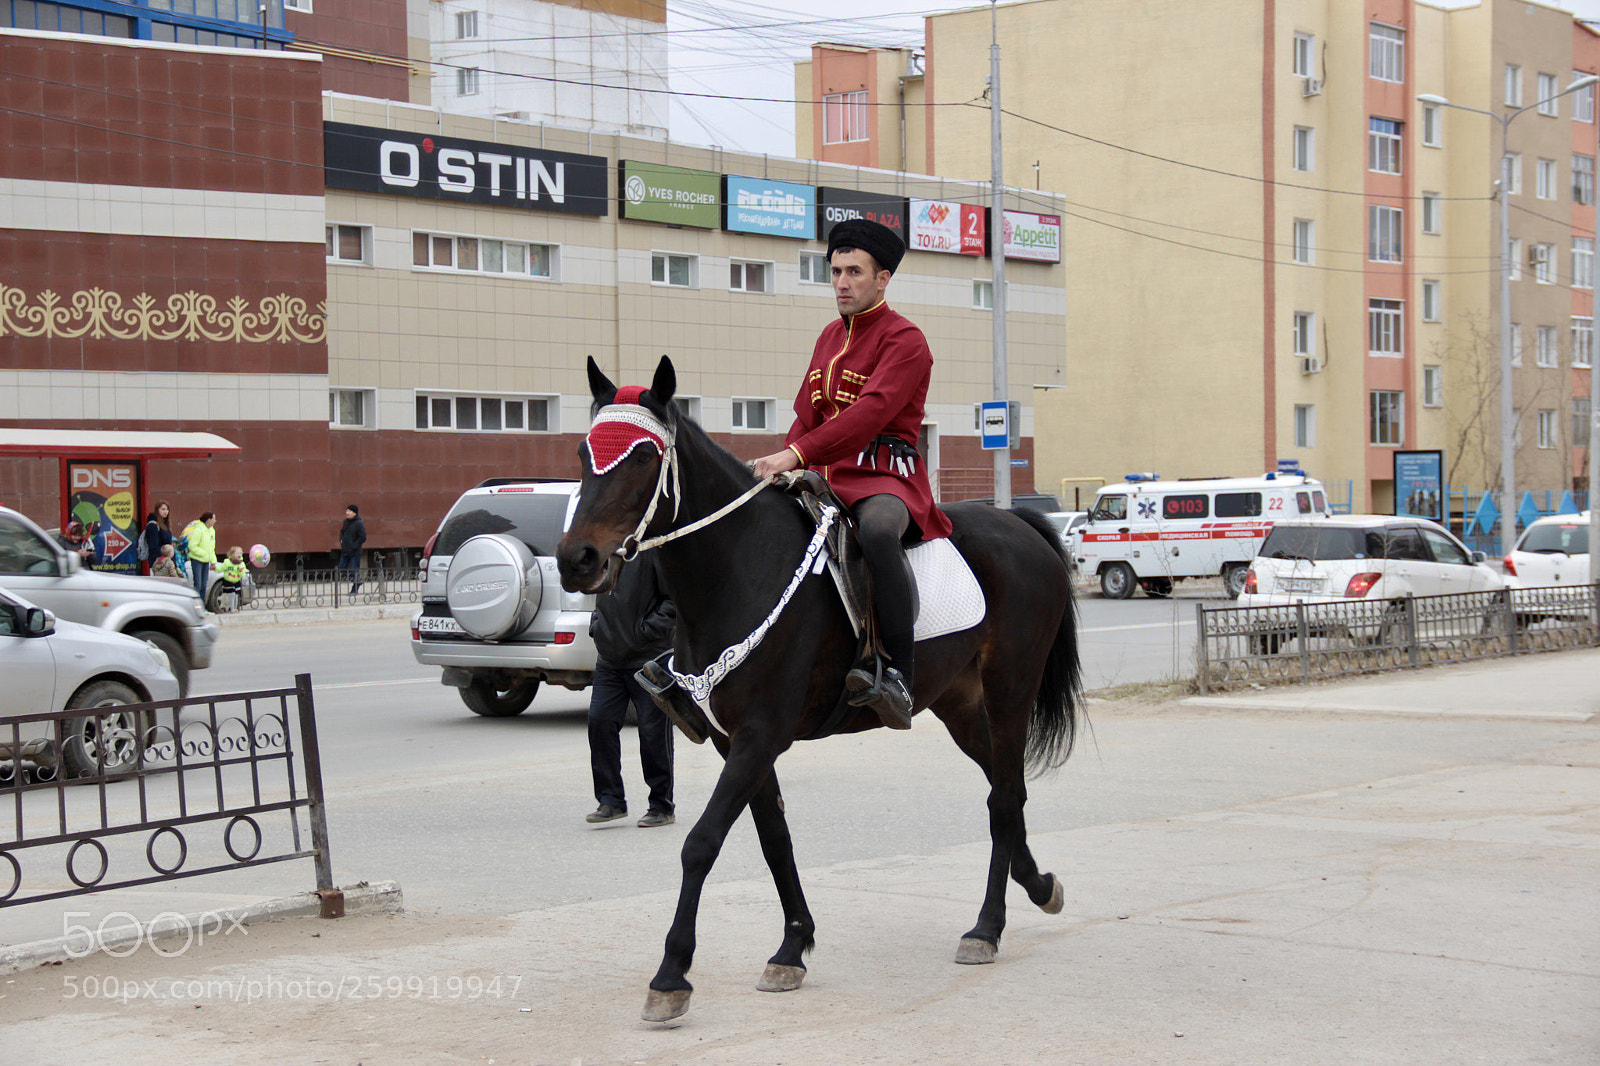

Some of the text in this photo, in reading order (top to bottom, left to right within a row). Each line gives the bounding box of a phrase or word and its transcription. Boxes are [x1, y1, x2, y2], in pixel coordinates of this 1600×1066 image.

[379, 138, 565, 204] O'STIN
[648, 186, 715, 205] YVES ROCHER
[826, 206, 864, 222] ОБУВЬ
[968, 213, 978, 235] 2
[917, 233, 952, 250] TOY.RU
[964, 237, 983, 248] ЭТАЖ
[1013, 224, 1057, 248] Appétit
[73, 468, 132, 488] DNS
[1180, 499, 1204, 514] 103
[1268, 497, 1284, 510] 22
[1225, 530, 1255, 538] ПОМОЩЬ
[108, 539, 119, 547] 250
[455, 580, 509, 594] LAND CRUISER
